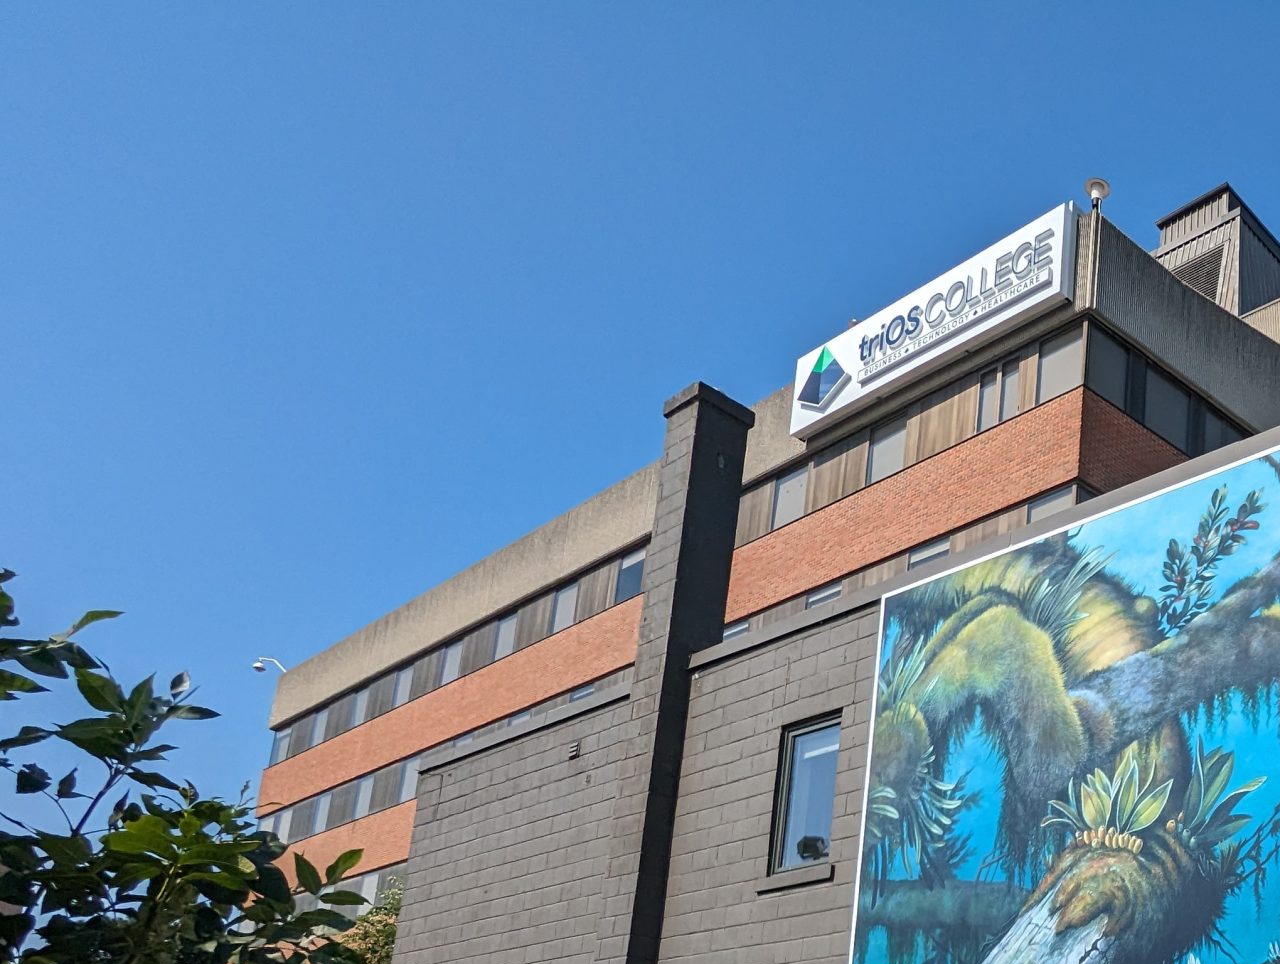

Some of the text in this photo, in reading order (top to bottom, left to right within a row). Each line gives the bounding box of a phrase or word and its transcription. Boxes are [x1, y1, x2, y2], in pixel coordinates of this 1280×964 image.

[864, 274, 1041, 376] BUSINESS TECHNOLOGY HEALTHCARE
[925, 228, 1055, 325] COLLEGE
